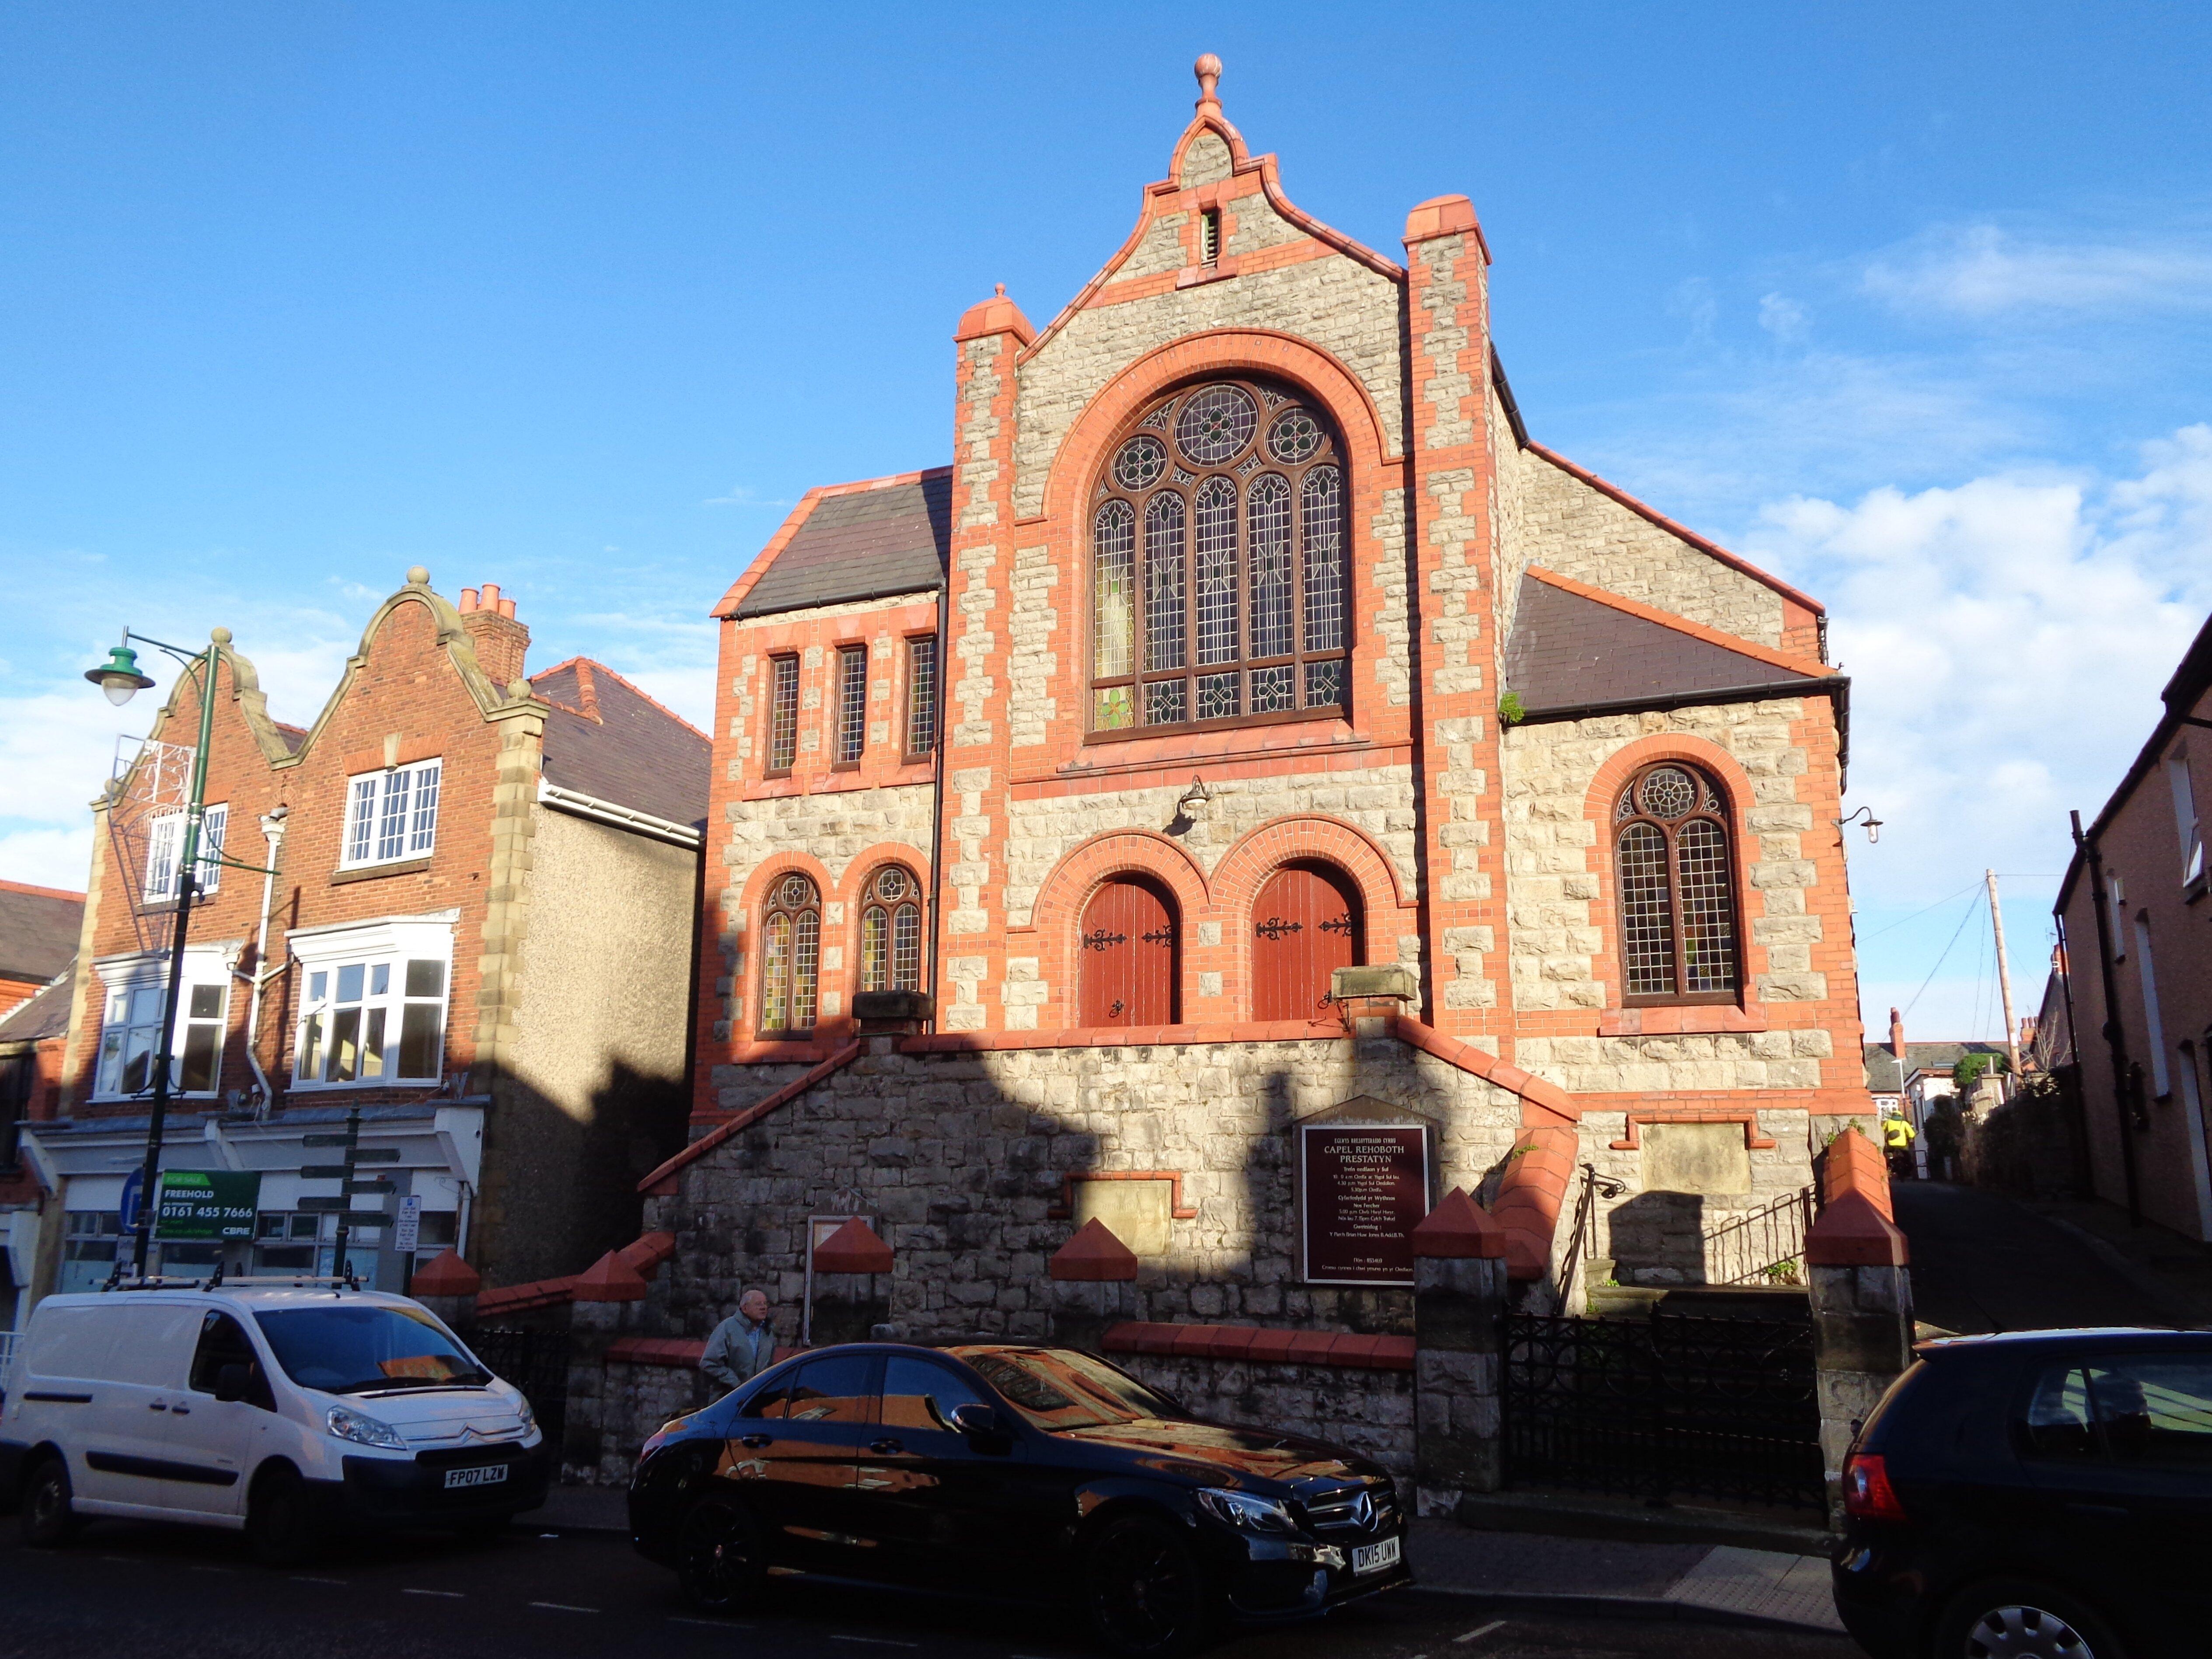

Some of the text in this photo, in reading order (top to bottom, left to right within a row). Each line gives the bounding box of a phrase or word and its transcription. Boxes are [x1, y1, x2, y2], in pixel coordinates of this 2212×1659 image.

[1340, 1155, 1392, 1163] PRESTATYN
[164, 1189, 214, 1199] FREEHOLD
[162, 1206, 253, 1218] 0161 455 7666
[222, 1227, 251, 1235] CBRE
[450, 1469, 481, 1485] FP07
[1357, 1544, 1379, 1568] DK15
